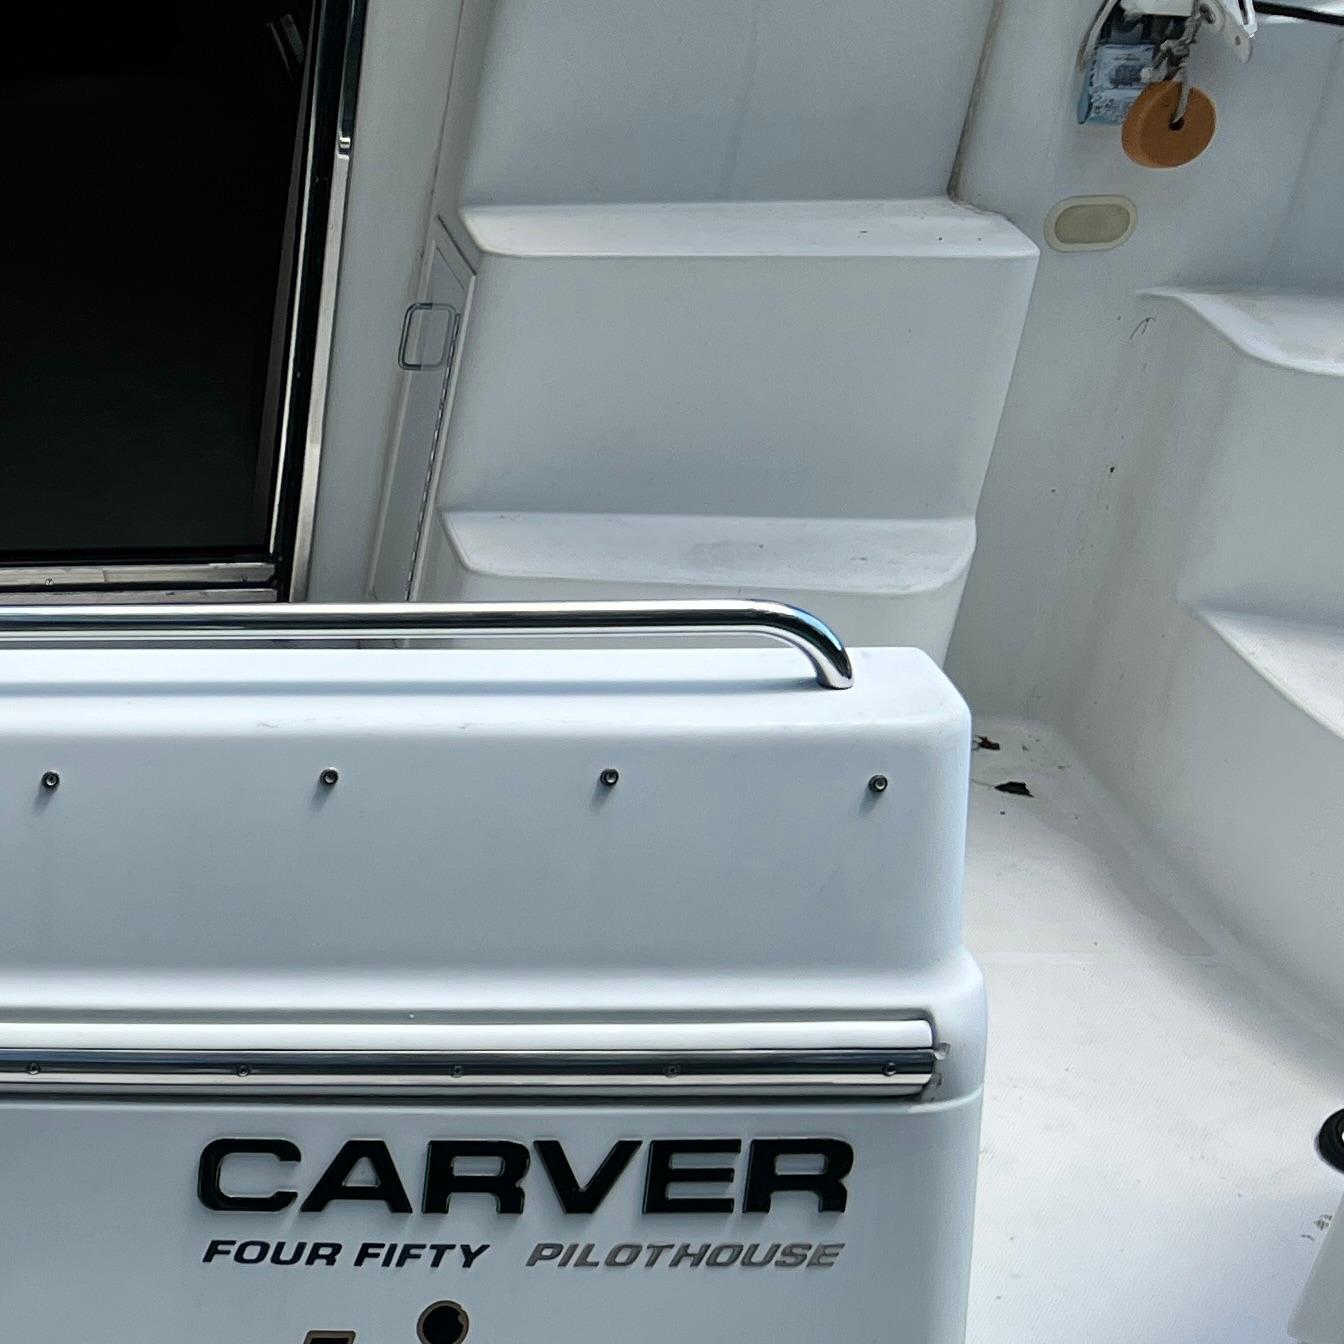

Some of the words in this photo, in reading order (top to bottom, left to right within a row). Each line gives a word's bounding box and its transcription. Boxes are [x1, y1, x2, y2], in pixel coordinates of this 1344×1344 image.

[196, 1138, 854, 1215] CARVER
[201, 1239, 343, 1268] FOUR
[353, 1242, 492, 1270] FIFTY
[525, 1242, 846, 1270] PILOTHOUSE
